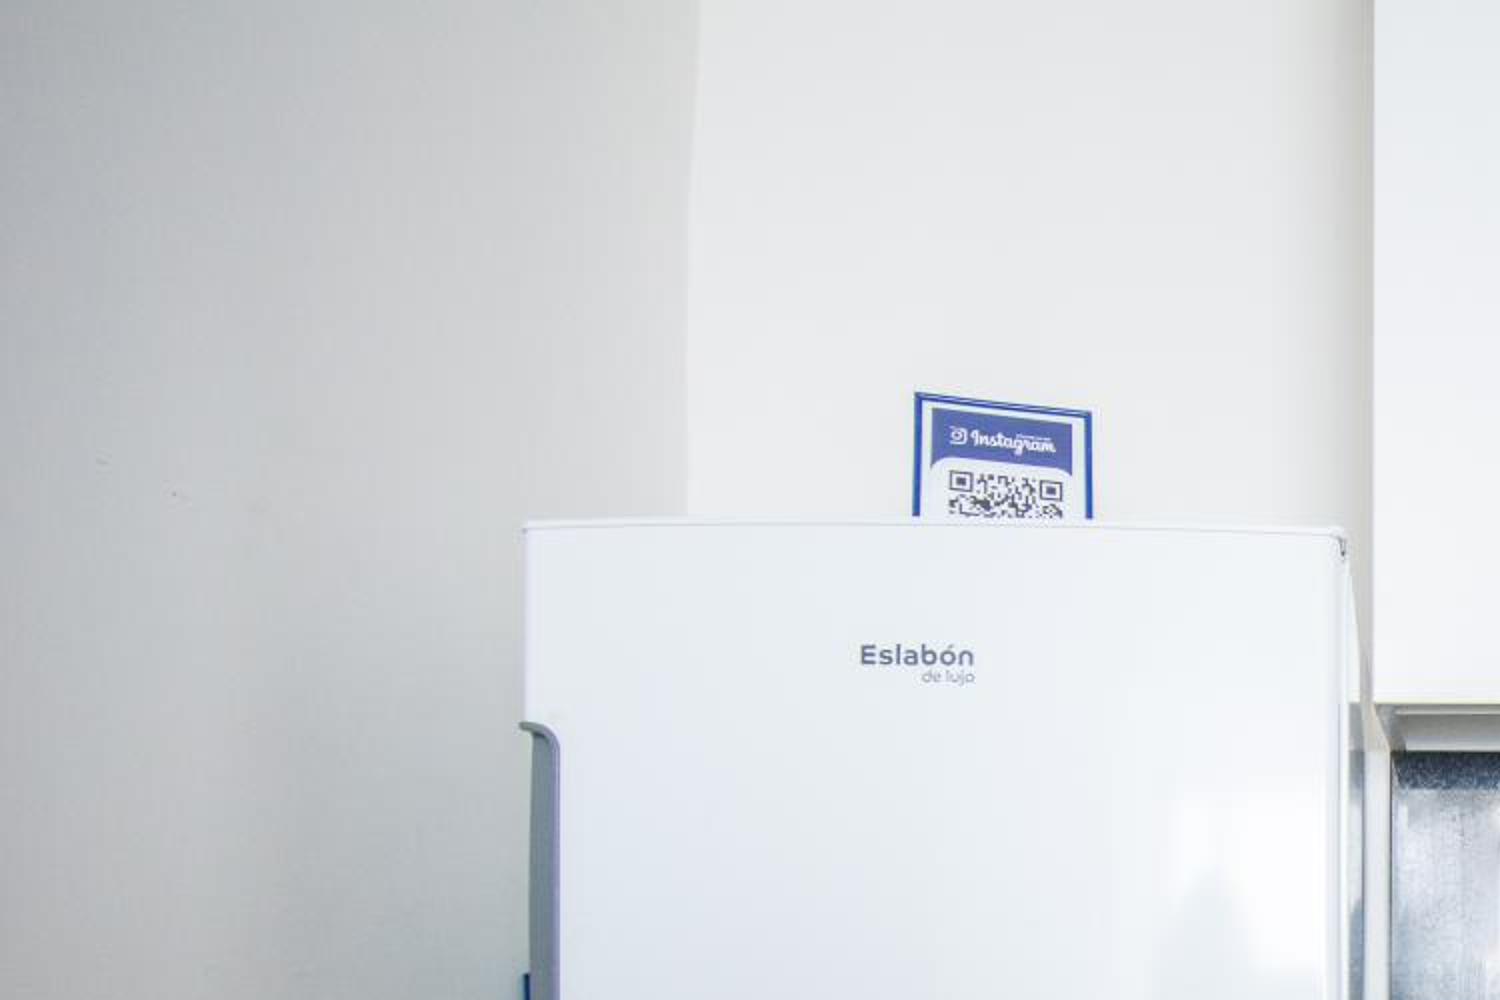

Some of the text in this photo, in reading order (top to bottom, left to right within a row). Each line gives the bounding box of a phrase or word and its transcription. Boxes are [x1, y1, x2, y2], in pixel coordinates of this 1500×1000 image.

[970, 428, 1057, 456] Instagram
[860, 643, 974, 666] Eslabón
[921, 669, 975, 687] de lujo
